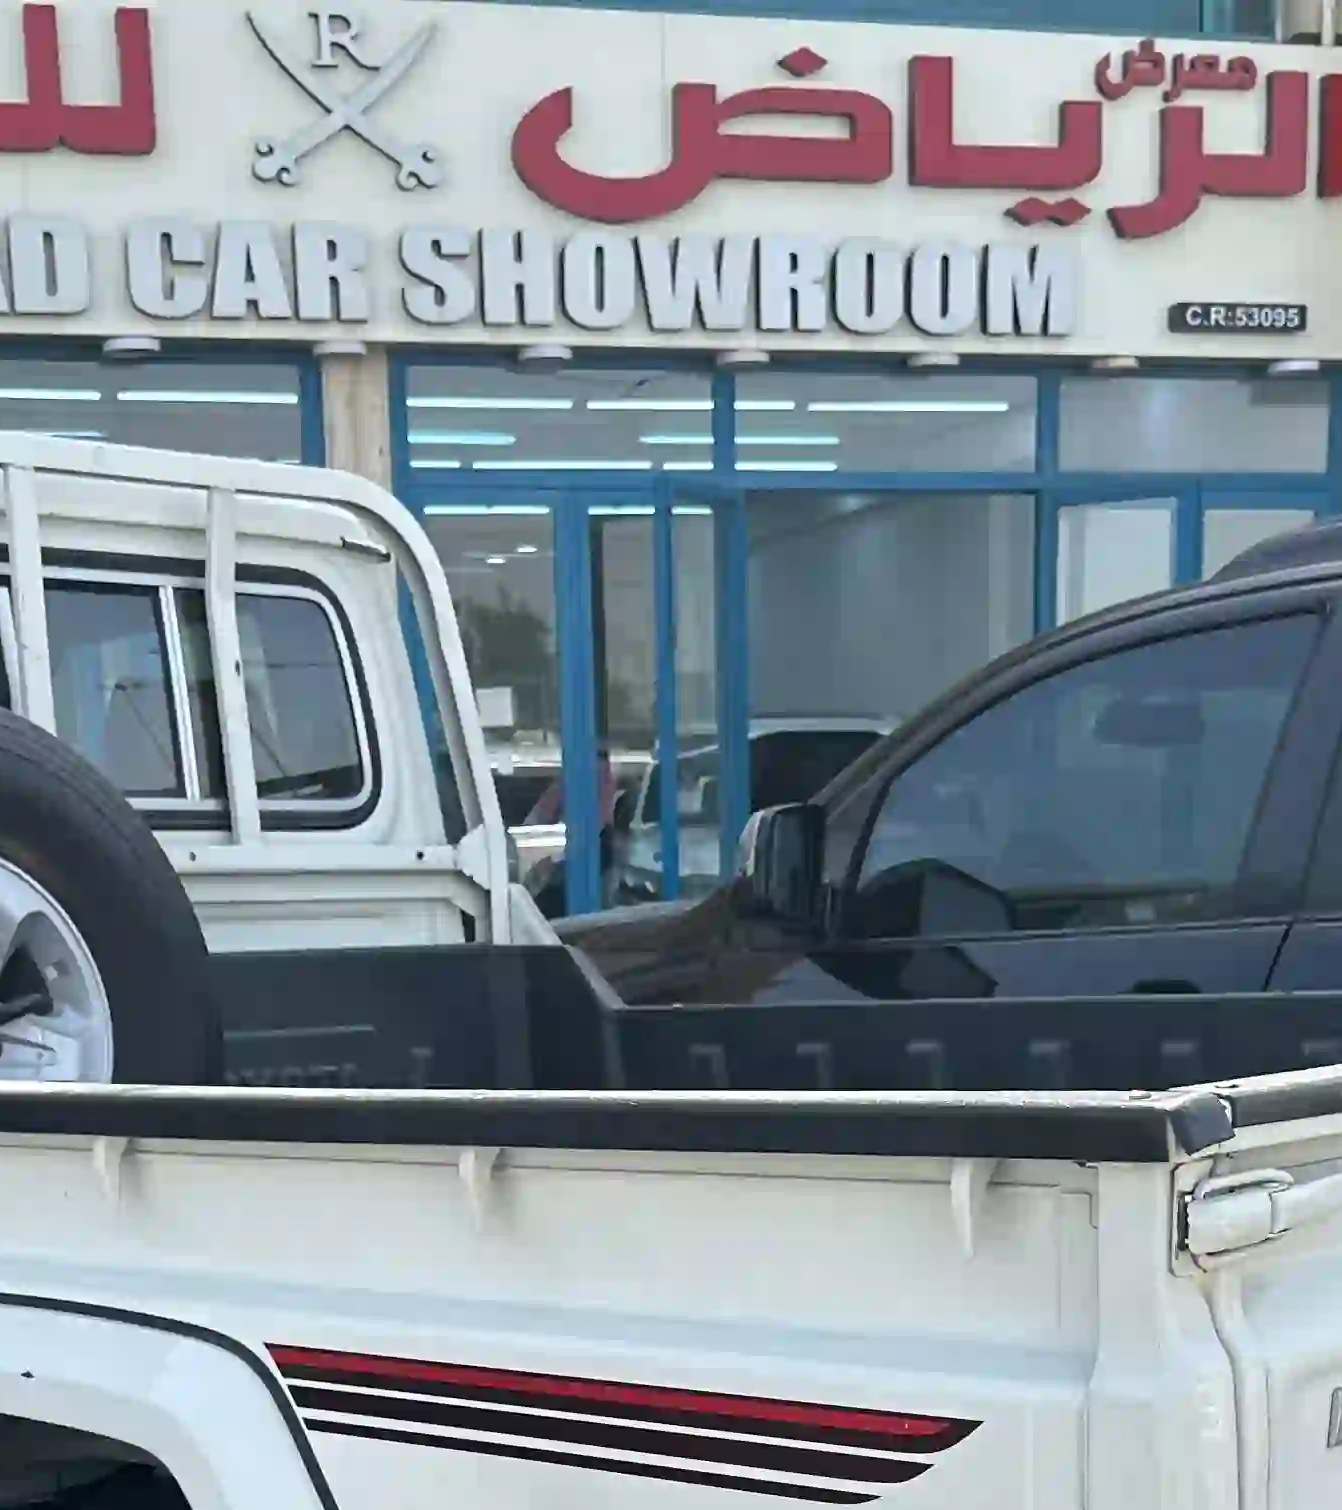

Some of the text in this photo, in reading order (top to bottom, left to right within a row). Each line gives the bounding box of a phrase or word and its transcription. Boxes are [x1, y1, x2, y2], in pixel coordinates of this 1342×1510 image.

[308, 11, 382, 70] R
[1095, 39, 1257, 102] معرض
[127, 216, 370, 323] CAR
[398, 225, 1073, 336] SHOWROOM
